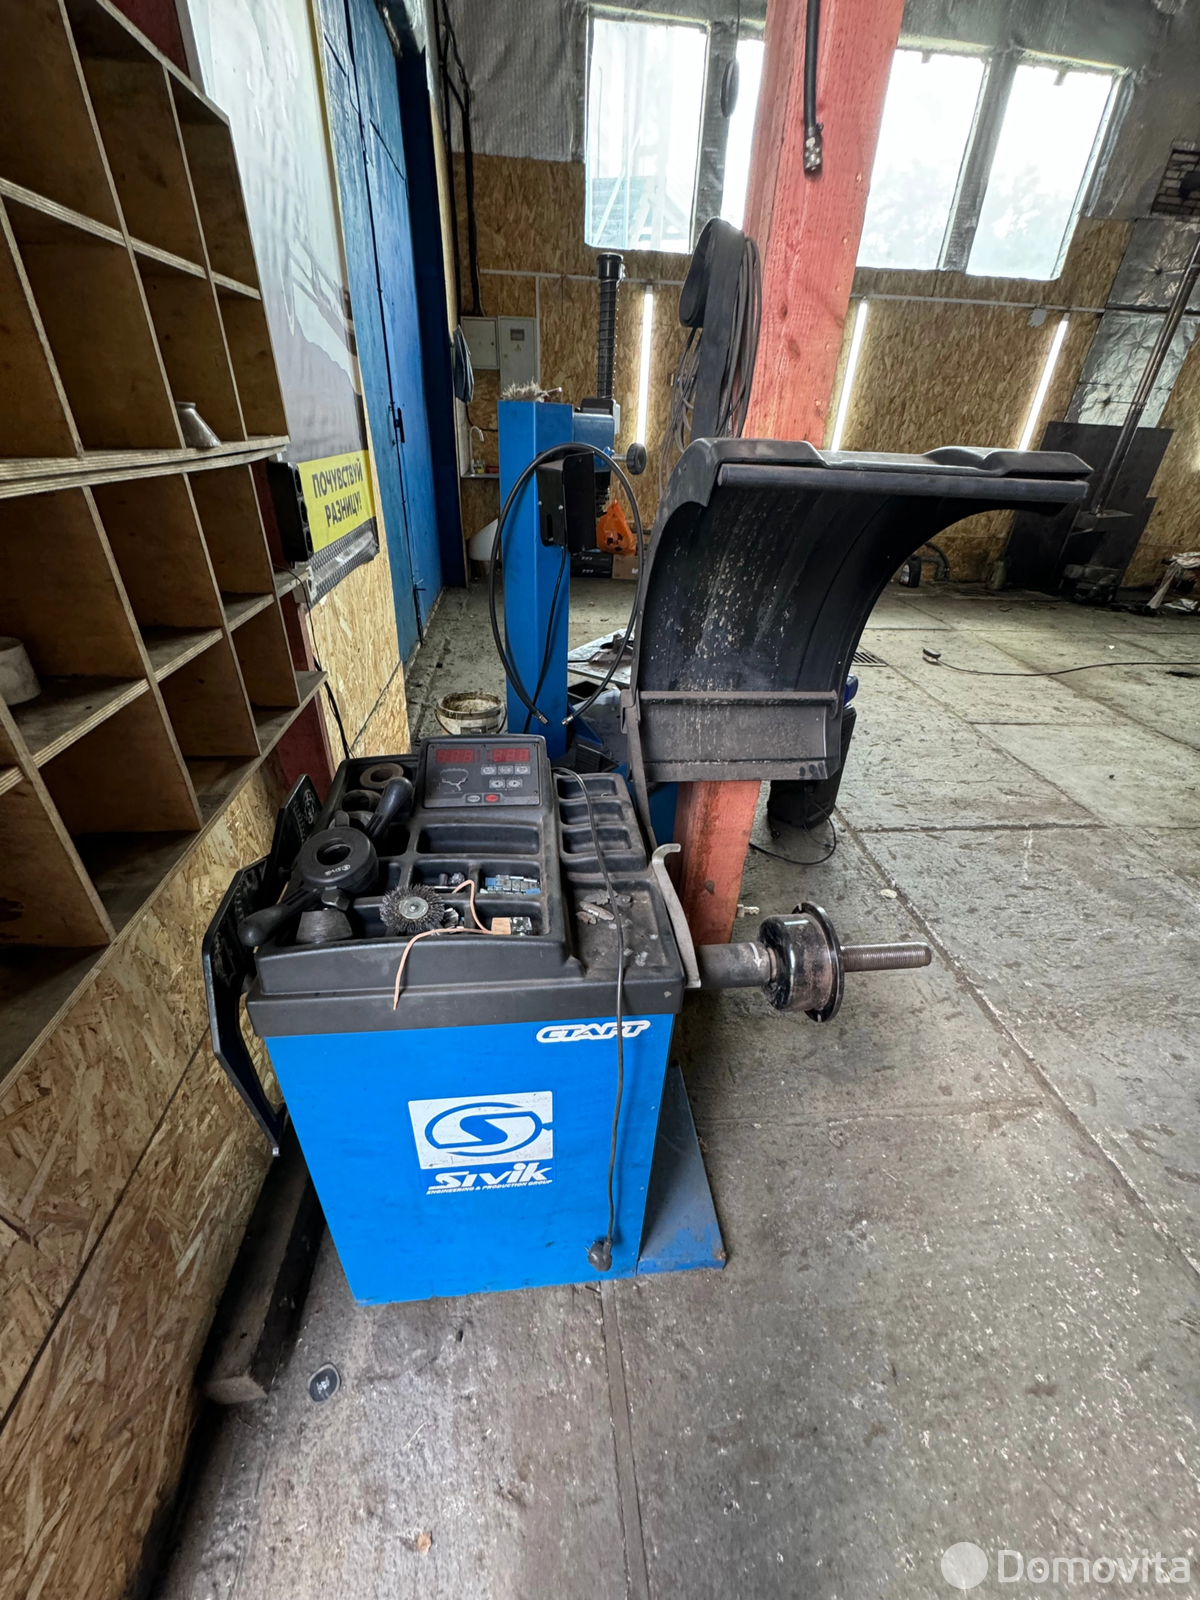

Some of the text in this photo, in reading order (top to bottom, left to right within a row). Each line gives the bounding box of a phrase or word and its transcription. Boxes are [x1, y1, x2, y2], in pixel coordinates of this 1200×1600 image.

[311, 458, 363, 499] ПОЧУВСТВУЙ
[324, 491, 362, 528] РАЗНИЦУ!
[426, 1186, 474, 1195] ENGINEERING
[482, 1181, 527, 1190] PRODUCTION
[528, 1179, 553, 1188] GROUP
